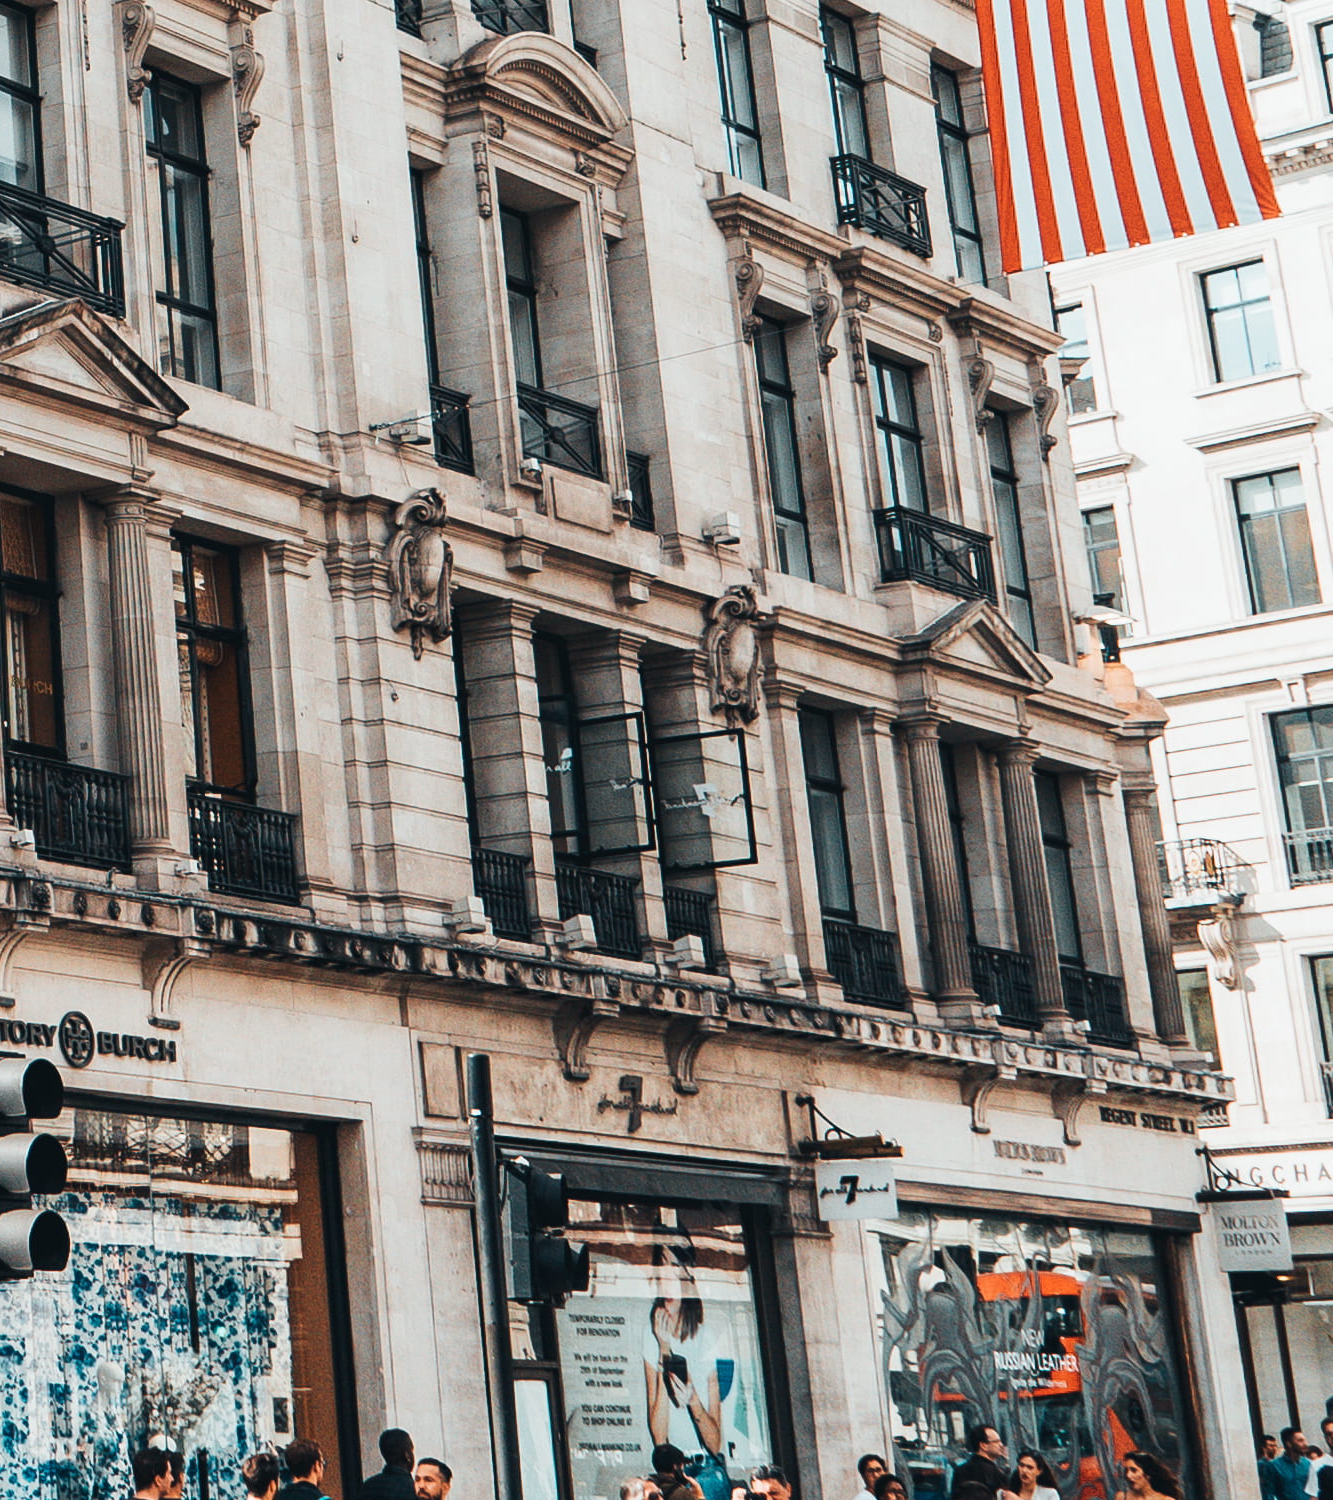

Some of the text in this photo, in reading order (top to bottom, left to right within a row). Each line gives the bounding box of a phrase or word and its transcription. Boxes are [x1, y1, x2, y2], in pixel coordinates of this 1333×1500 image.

[97, 1031, 176, 1062] BURCH
[1099, 1105, 1137, 1127] REGENT
[1141, 1113, 1177, 1132] STREET
[840, 1175, 860, 1206] 7
[1221, 1215, 1279, 1231] MOLTON
[1223, 1232, 1281, 1248] BROWN
[1021, 1328, 1044, 1348] NEW
[994, 1351, 1079, 1372] RUSSIAN LEATHER
